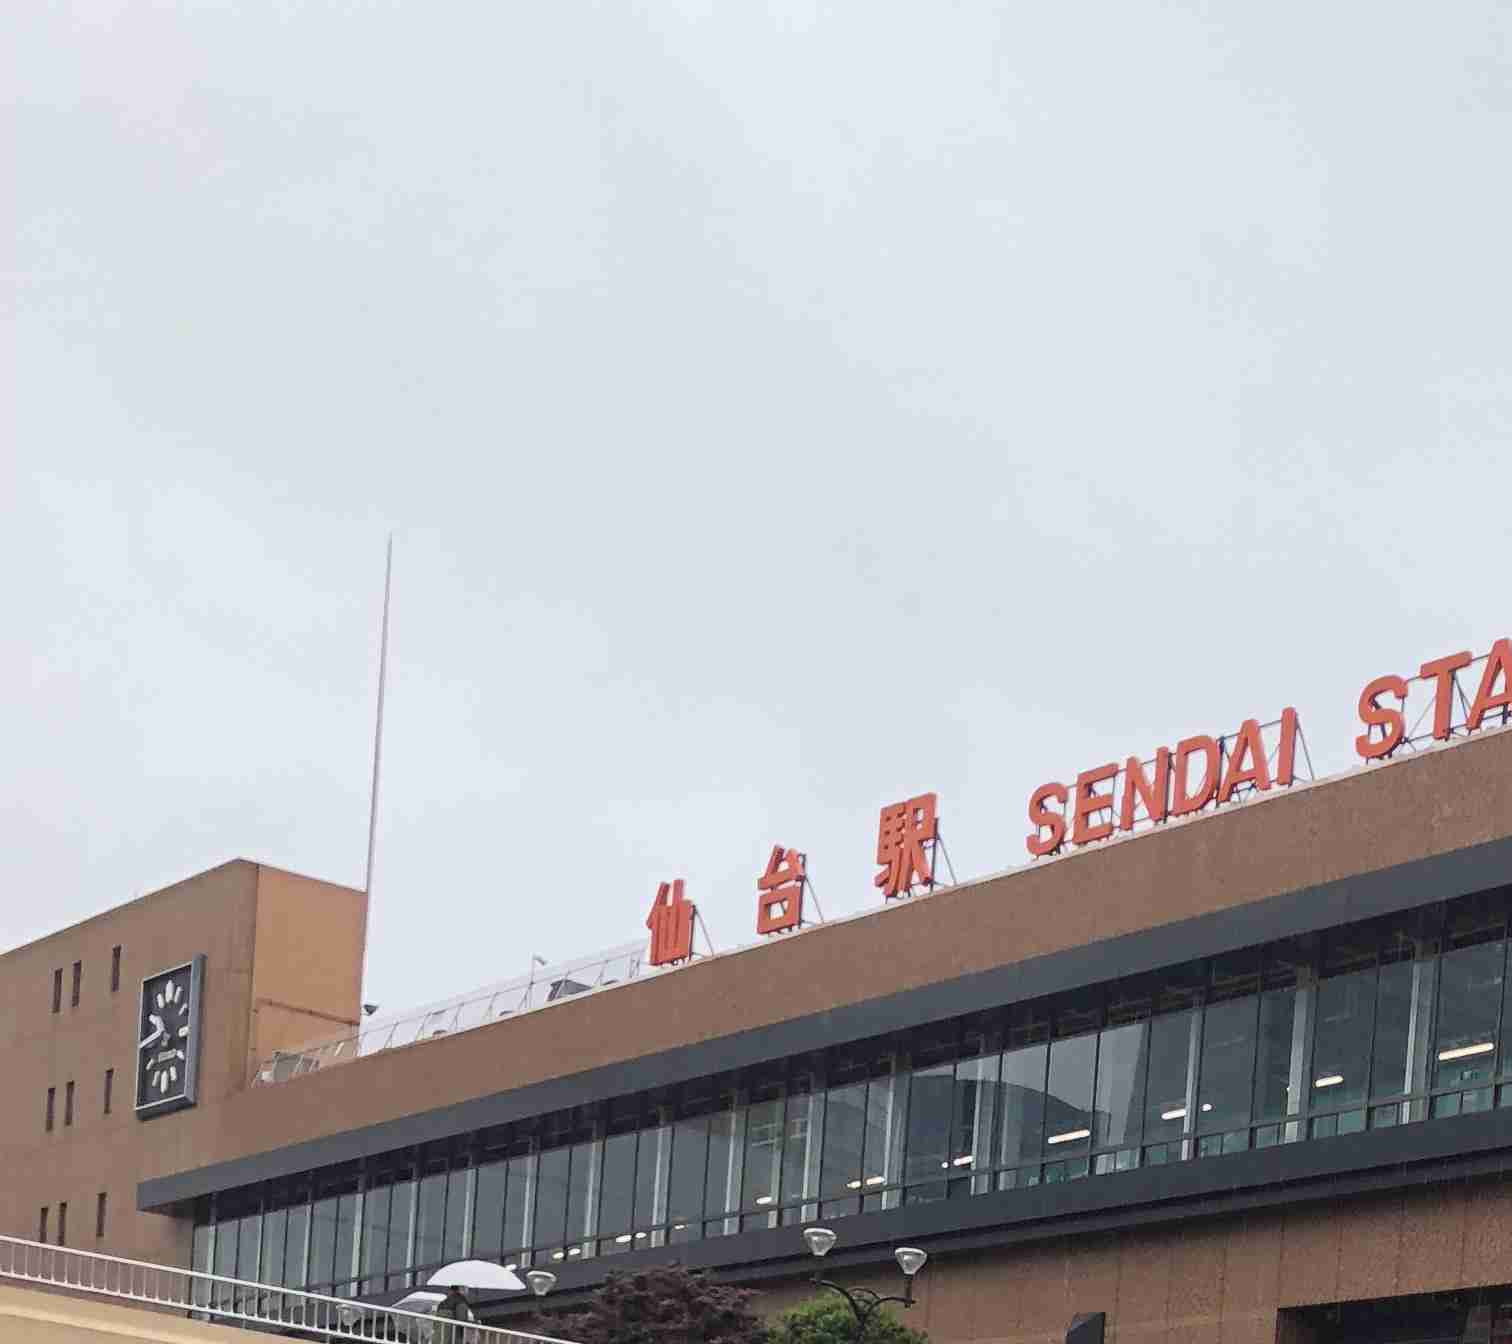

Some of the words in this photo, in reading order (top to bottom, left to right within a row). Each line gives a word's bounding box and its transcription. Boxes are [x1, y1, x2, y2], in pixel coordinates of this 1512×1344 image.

[1029, 710, 1294, 854] SENDAI
[649, 796, 934, 963] 仙台駅
